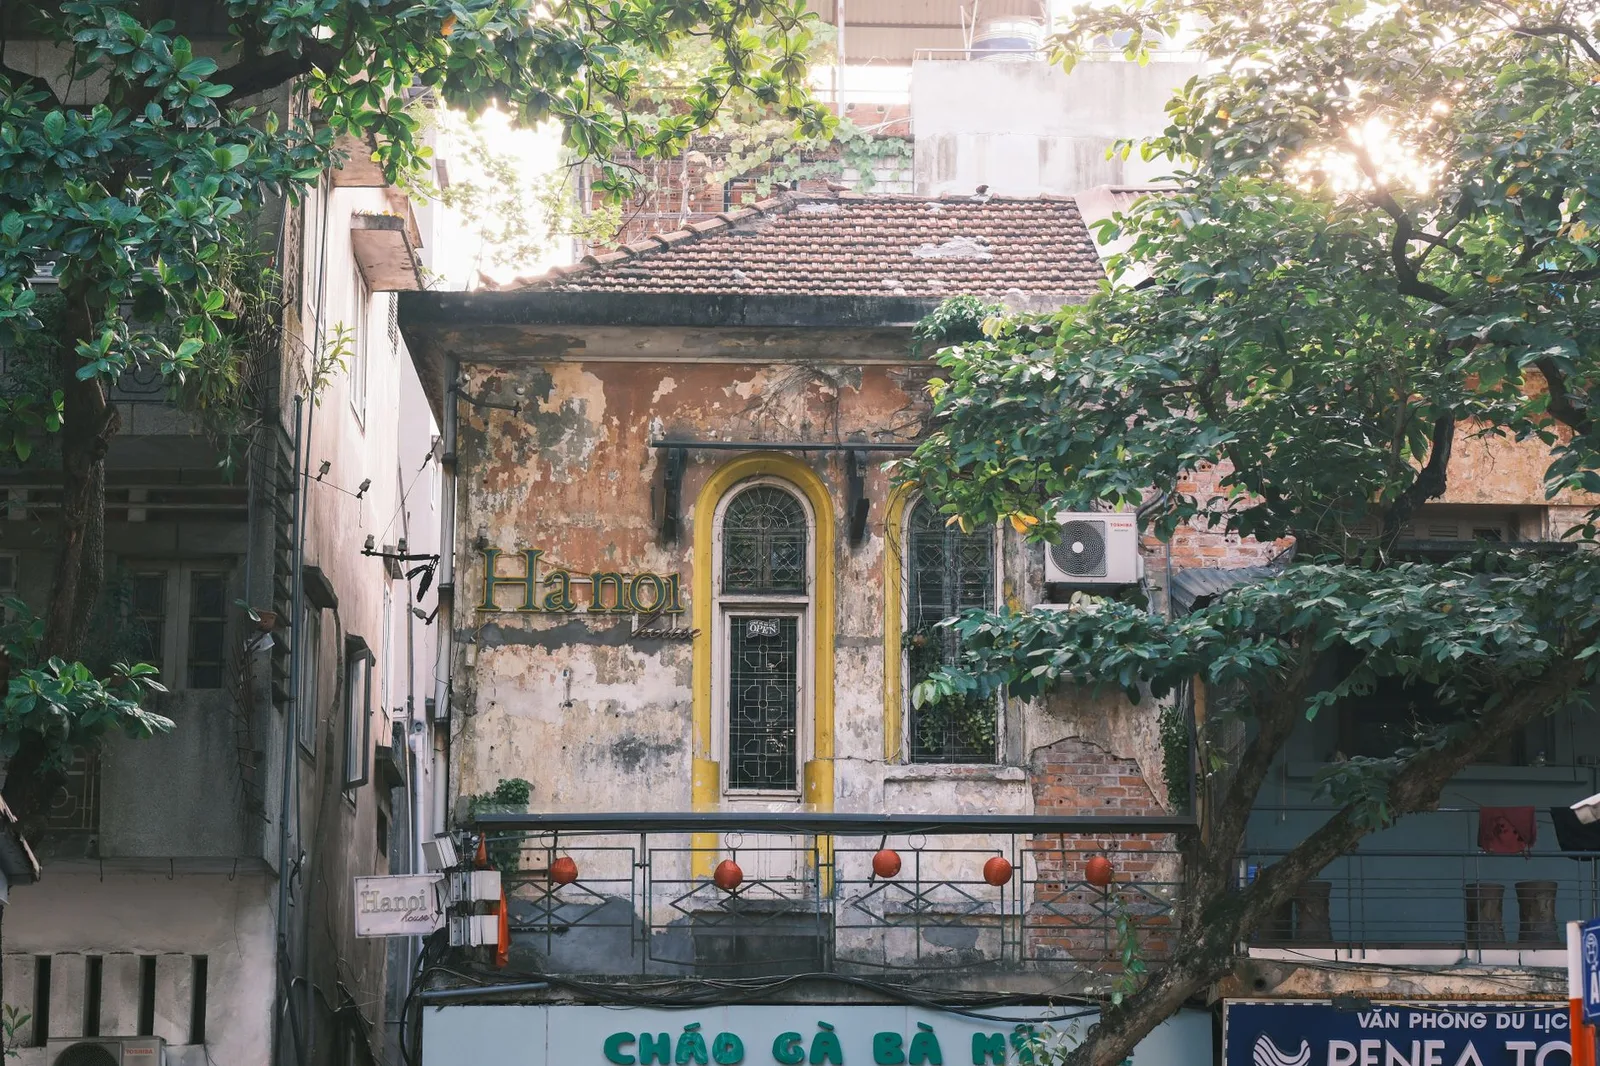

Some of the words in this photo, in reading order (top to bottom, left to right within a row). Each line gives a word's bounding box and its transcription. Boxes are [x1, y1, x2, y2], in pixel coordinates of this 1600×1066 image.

[477, 548, 685, 613] Hanoi
[631, 611, 702, 639] house
[749, 623, 777, 635] OPEN
[360, 888, 428, 914] Hanoi
[400, 909, 431, 923] house
[1357, 1008, 1399, 1029] VĂN
[1408, 1008, 1488, 1029] PHÒNG
[1496, 1013, 1525, 1029] DU
[1534, 1012, 1572, 1034] LỊC
[125, 1048, 154, 1056] TOSHIBA
[603, 1022, 744, 1066] CHÁO
[771, 1020, 843, 1066] GÀ
[872, 1021, 942, 1066] BÀ
